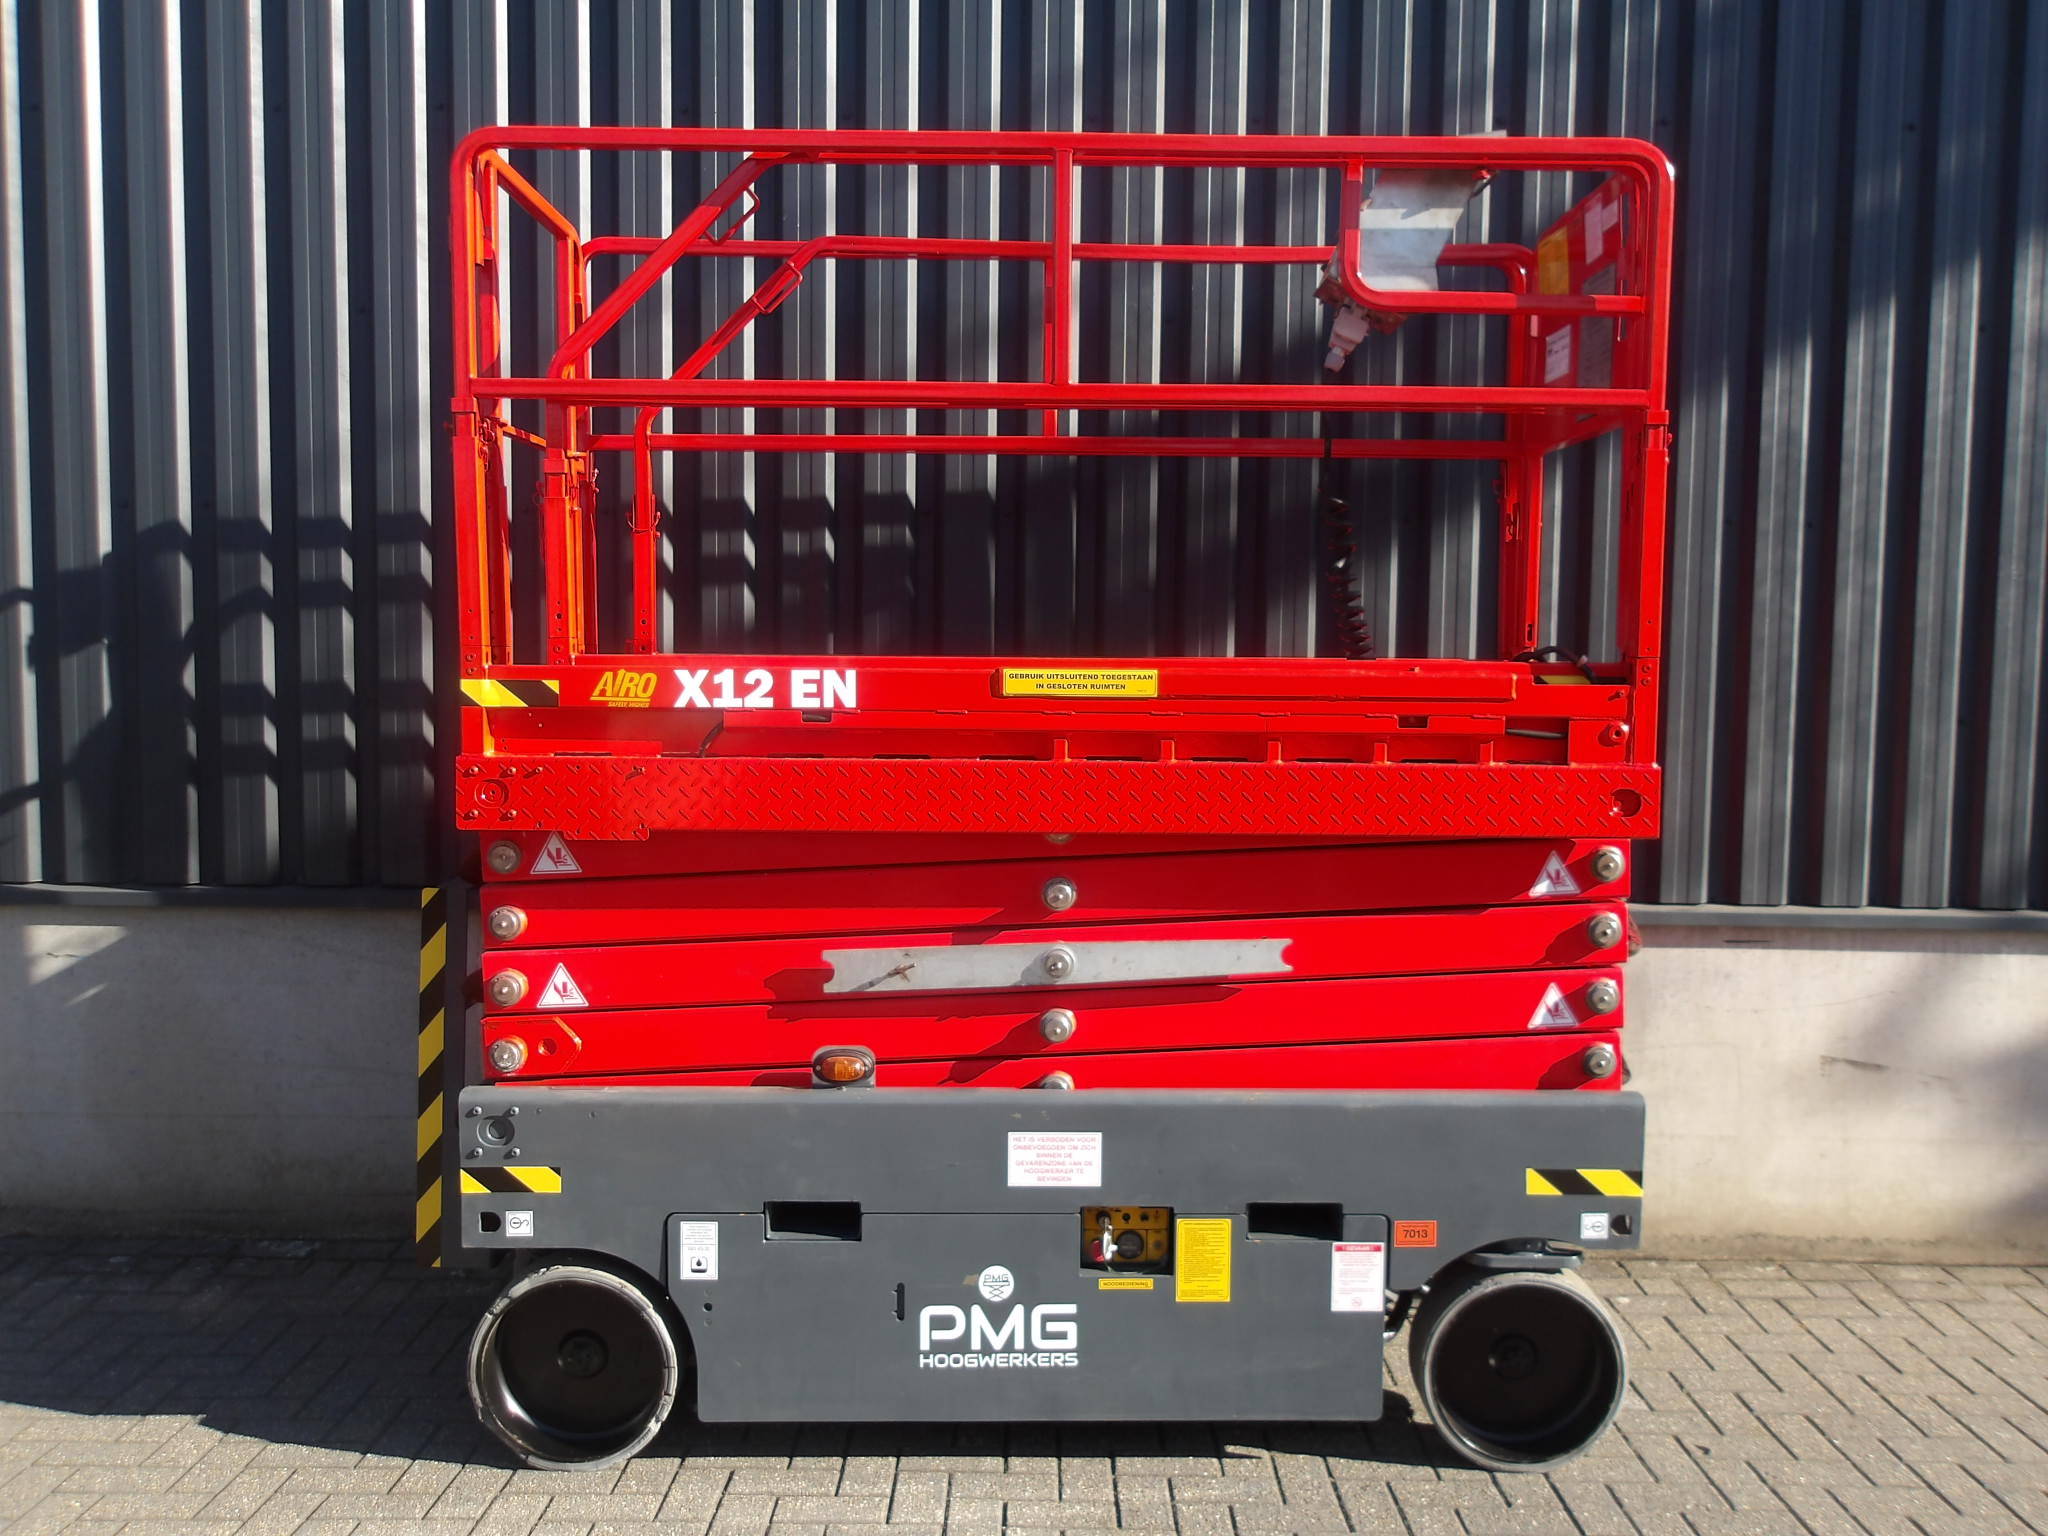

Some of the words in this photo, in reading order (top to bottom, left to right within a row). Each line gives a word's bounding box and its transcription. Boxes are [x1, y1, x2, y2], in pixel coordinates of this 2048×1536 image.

[592, 669, 657, 698] AIRO
[674, 669, 773, 708] X12
[790, 669, 858, 708] EN
[1402, 1229, 1428, 1239] 7013
[983, 1273, 1009, 1282] PMG
[919, 1303, 1078, 1351] PMG
[919, 1352, 1079, 1369] HOOGWERKERS
